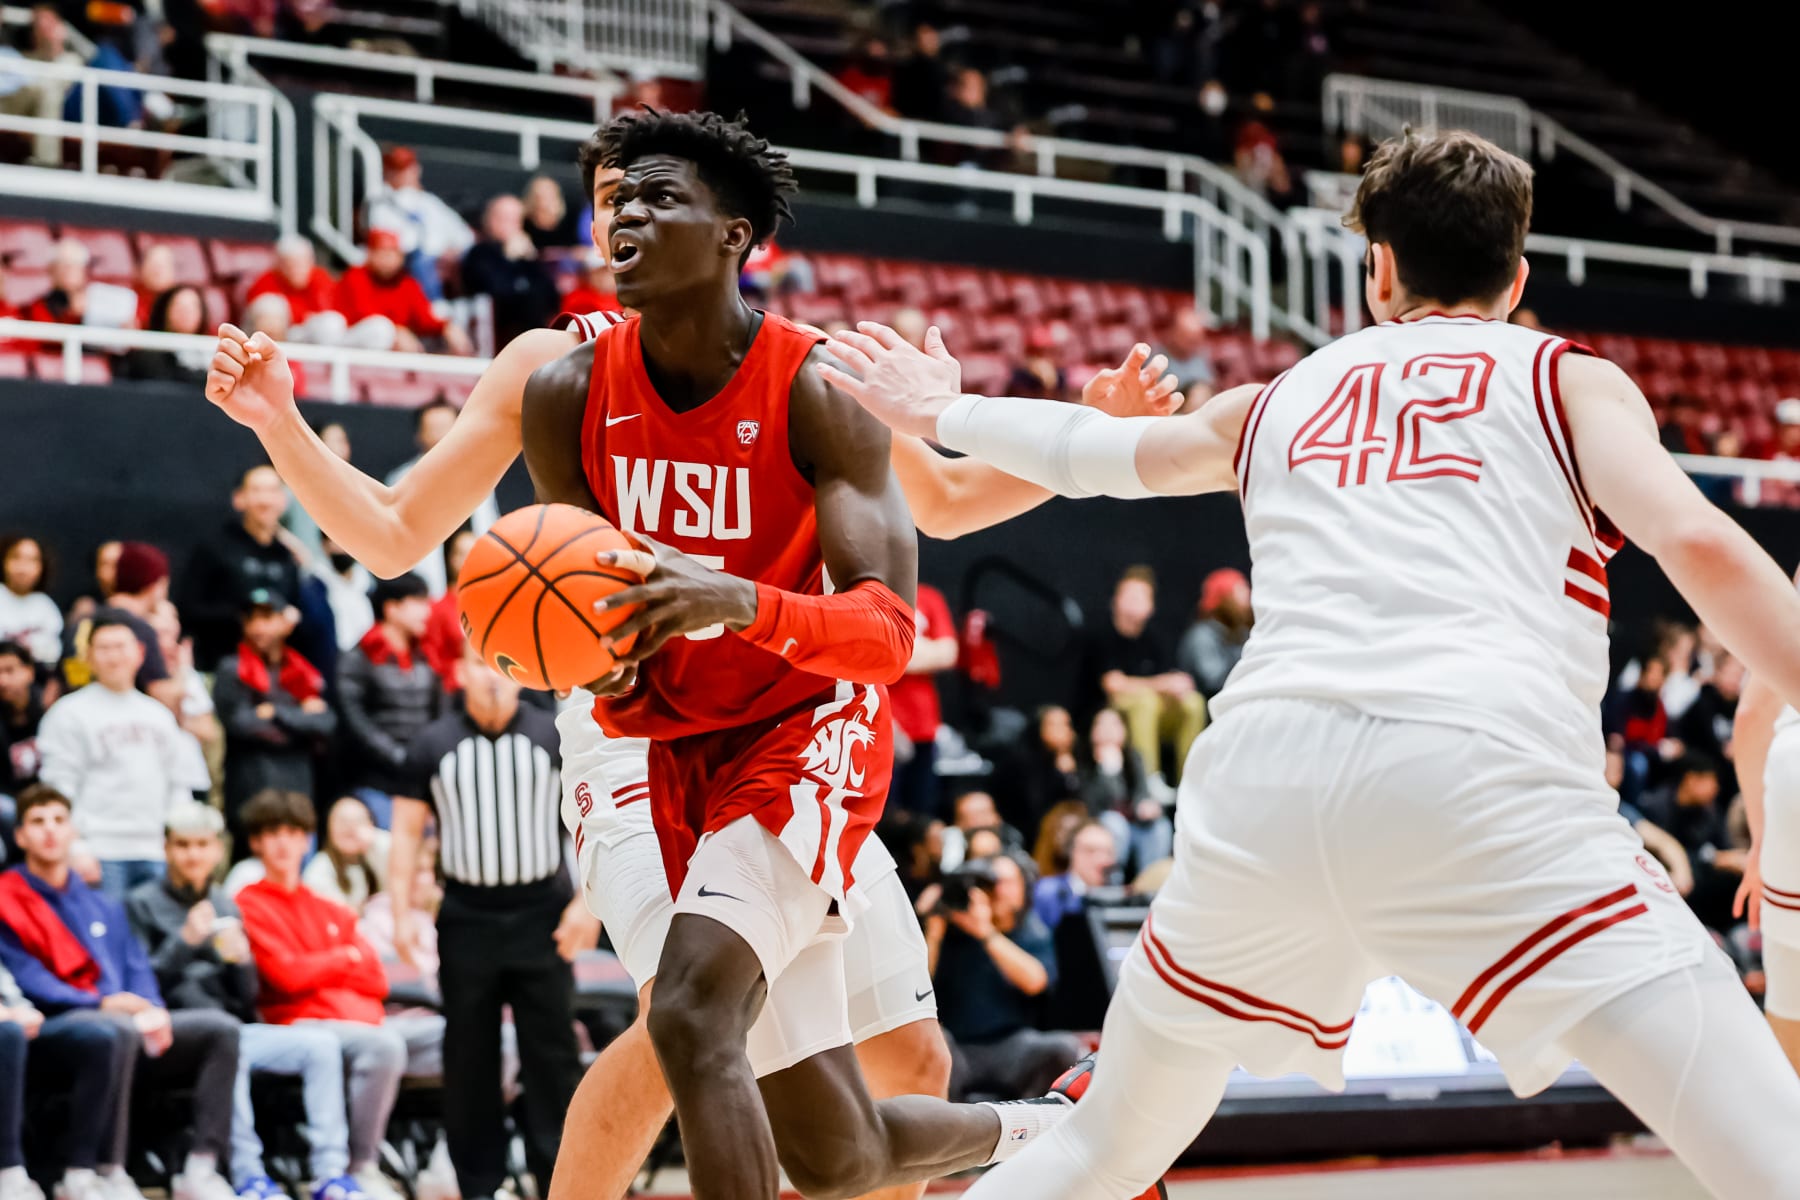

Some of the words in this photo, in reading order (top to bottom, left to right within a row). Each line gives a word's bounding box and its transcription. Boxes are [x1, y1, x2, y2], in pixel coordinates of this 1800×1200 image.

[737, 421, 759, 438] PAC
[1288, 352, 1496, 488] 42
[741, 433, 752, 444] 12
[610, 455, 752, 540] WSU
[575, 782, 593, 818] S
